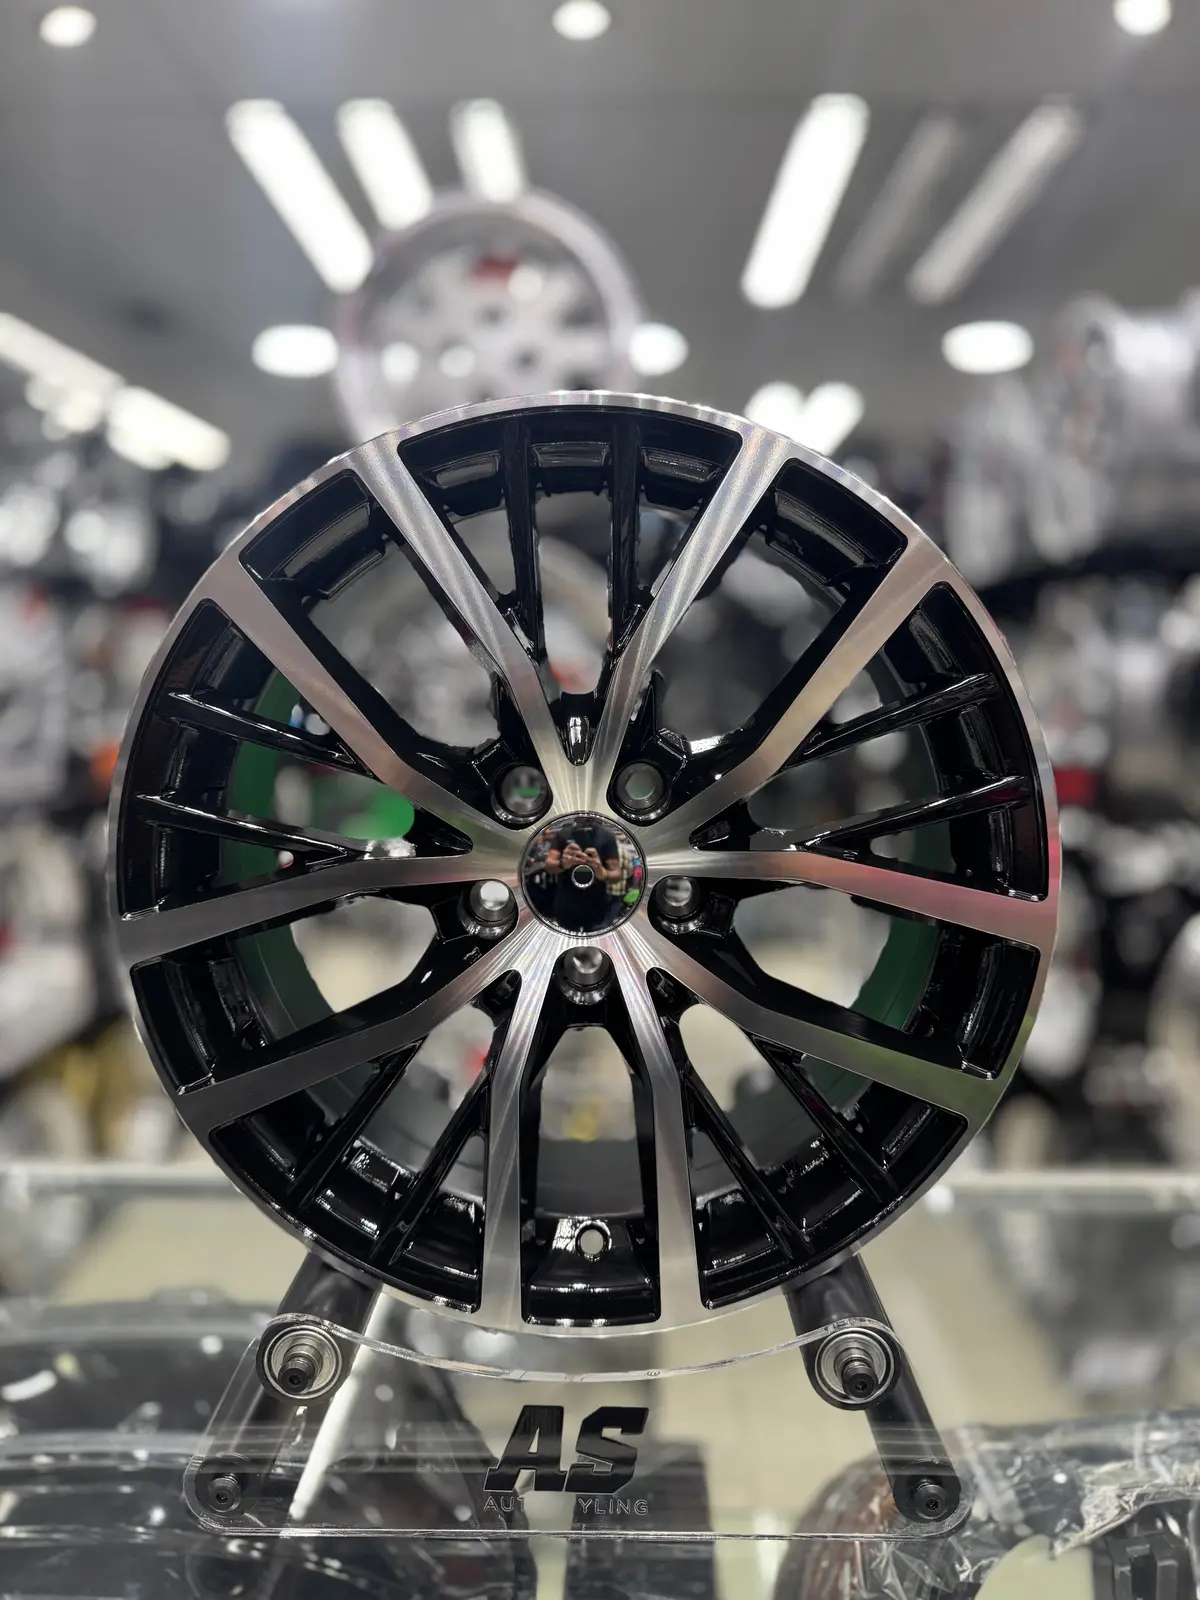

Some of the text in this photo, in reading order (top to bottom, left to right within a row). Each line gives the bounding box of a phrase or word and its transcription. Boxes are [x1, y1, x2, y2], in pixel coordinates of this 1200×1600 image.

[483, 1405, 649, 1495] AS
[483, 1495, 648, 1515] AUT YLING
